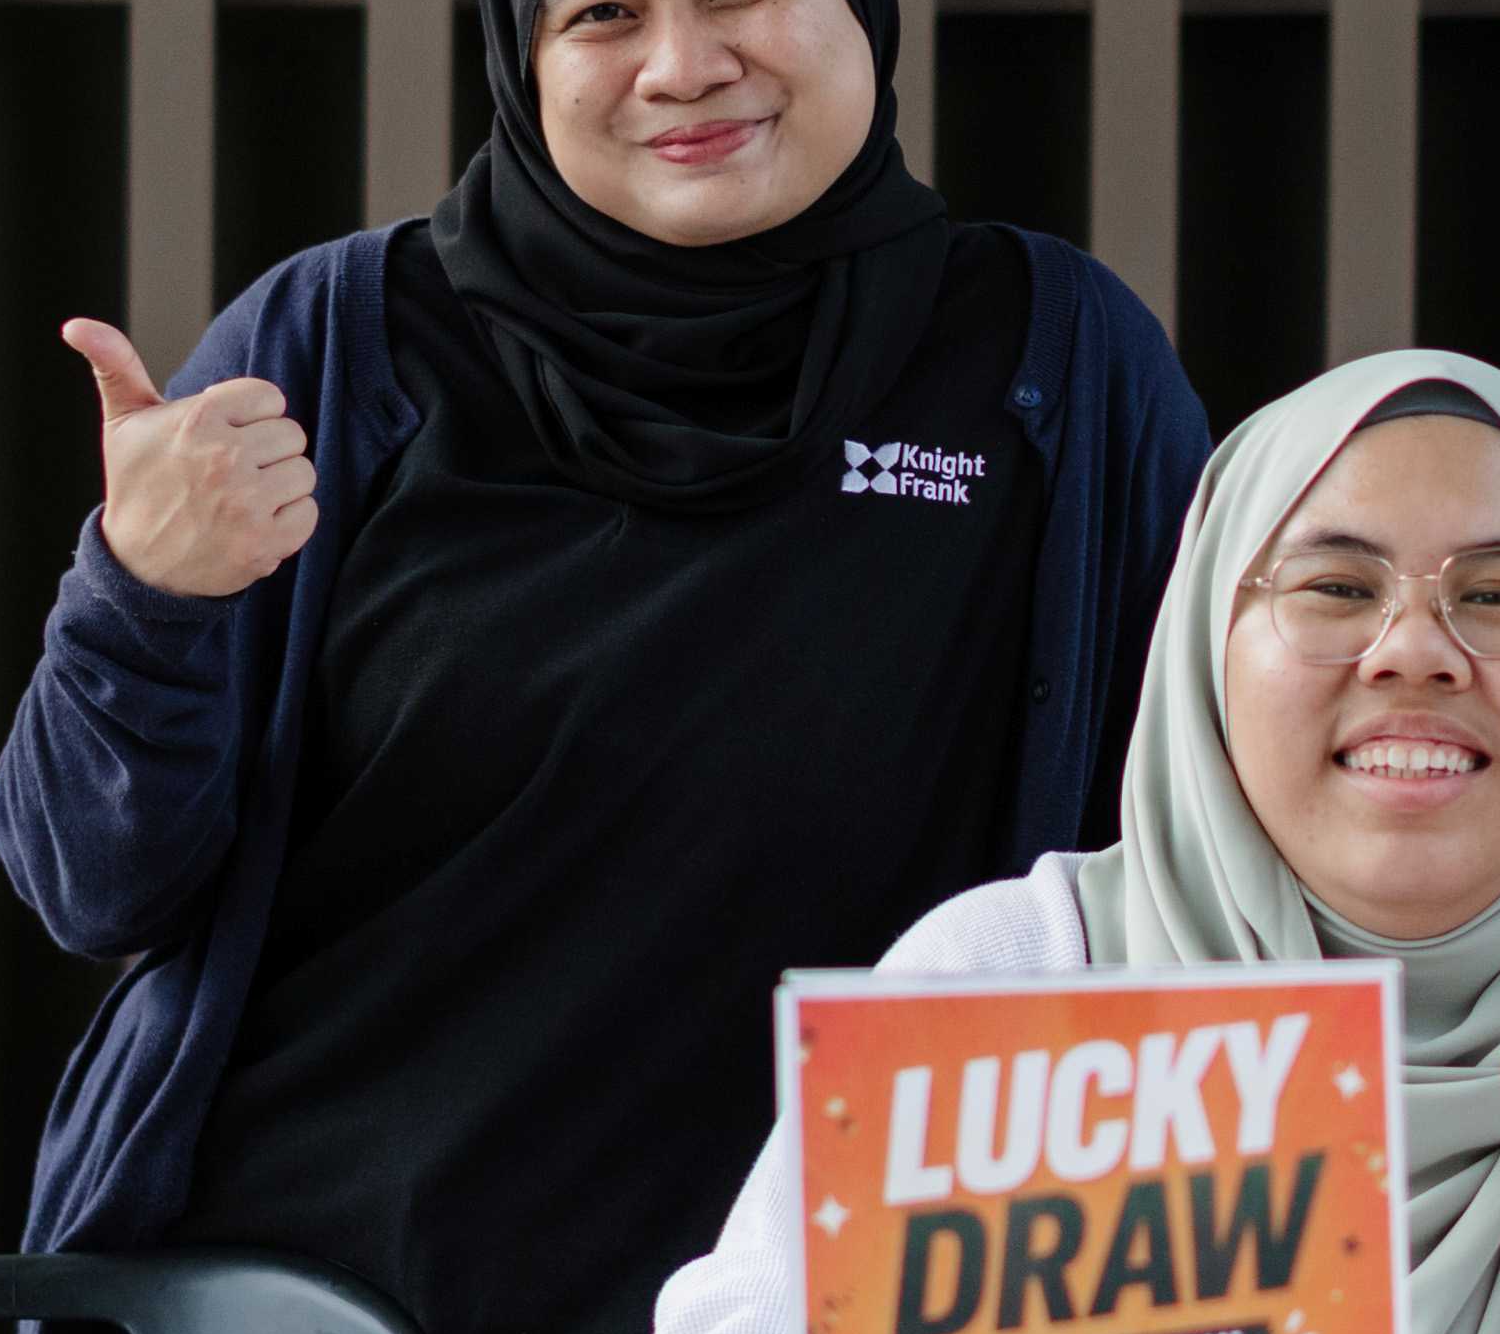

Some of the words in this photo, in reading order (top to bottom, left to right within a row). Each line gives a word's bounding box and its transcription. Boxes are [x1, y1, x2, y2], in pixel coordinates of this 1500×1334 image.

[901, 443, 986, 480] Knight
[899, 472, 971, 504] Frank
[883, 1012, 1310, 1206] LUCKY
